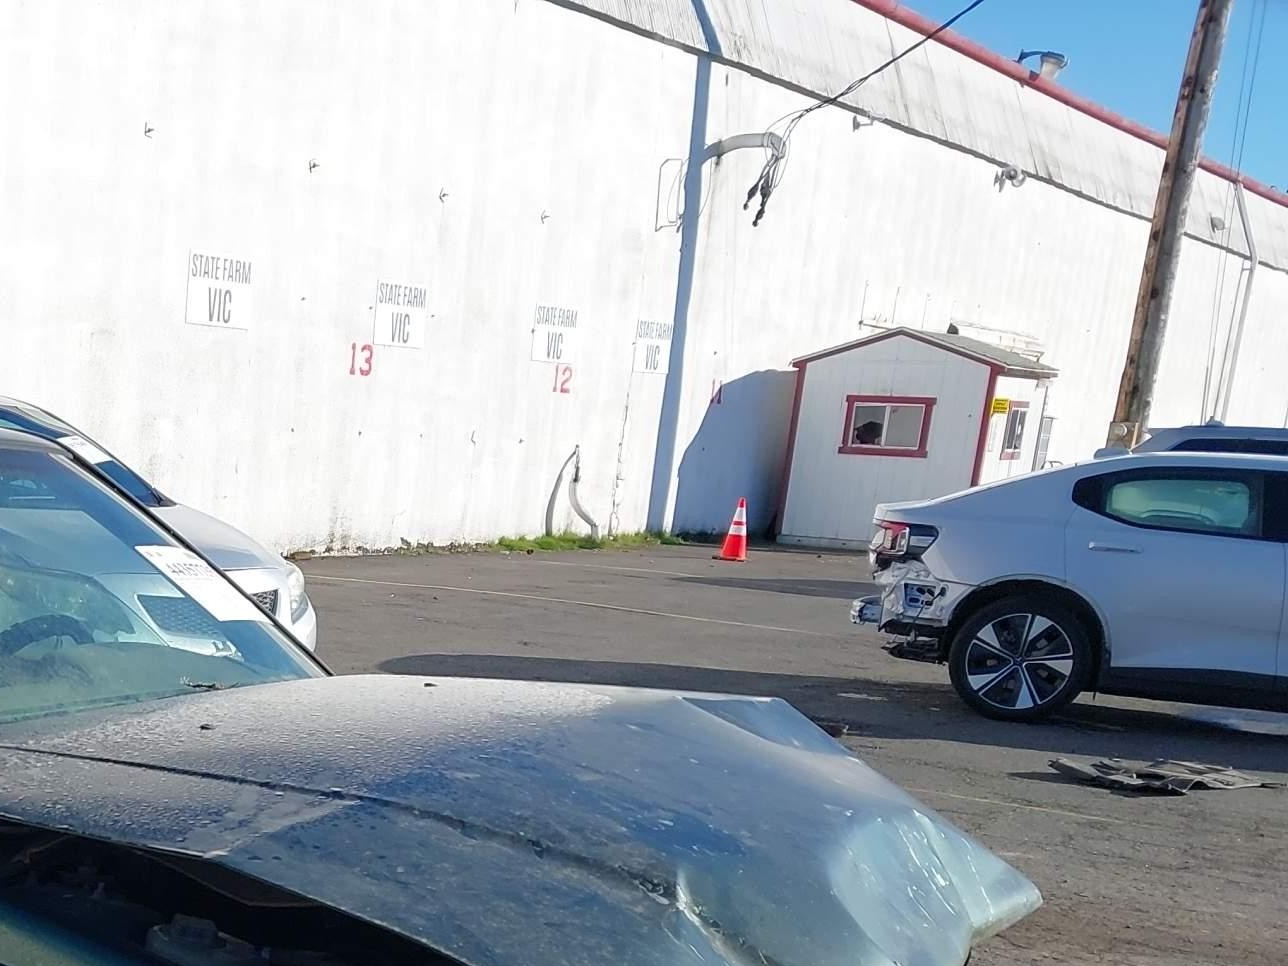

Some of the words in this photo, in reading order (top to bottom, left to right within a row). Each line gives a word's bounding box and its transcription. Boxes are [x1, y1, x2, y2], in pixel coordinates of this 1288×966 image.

[192, 253, 221, 280] STATE
[222, 258, 252, 285] FARM
[208, 286, 232, 324] VIC
[378, 282, 403, 306] STATE
[402, 286, 427, 309] FARM
[391, 311, 411, 344] VIC
[536, 305, 558, 326] STATE
[557, 308, 578, 329] FARM
[638, 320, 655, 341] STATE
[349, 342, 373, 376] 13
[546, 331, 564, 360] VIC
[645, 344, 661, 371] VIC
[552, 364, 573, 394] 12
